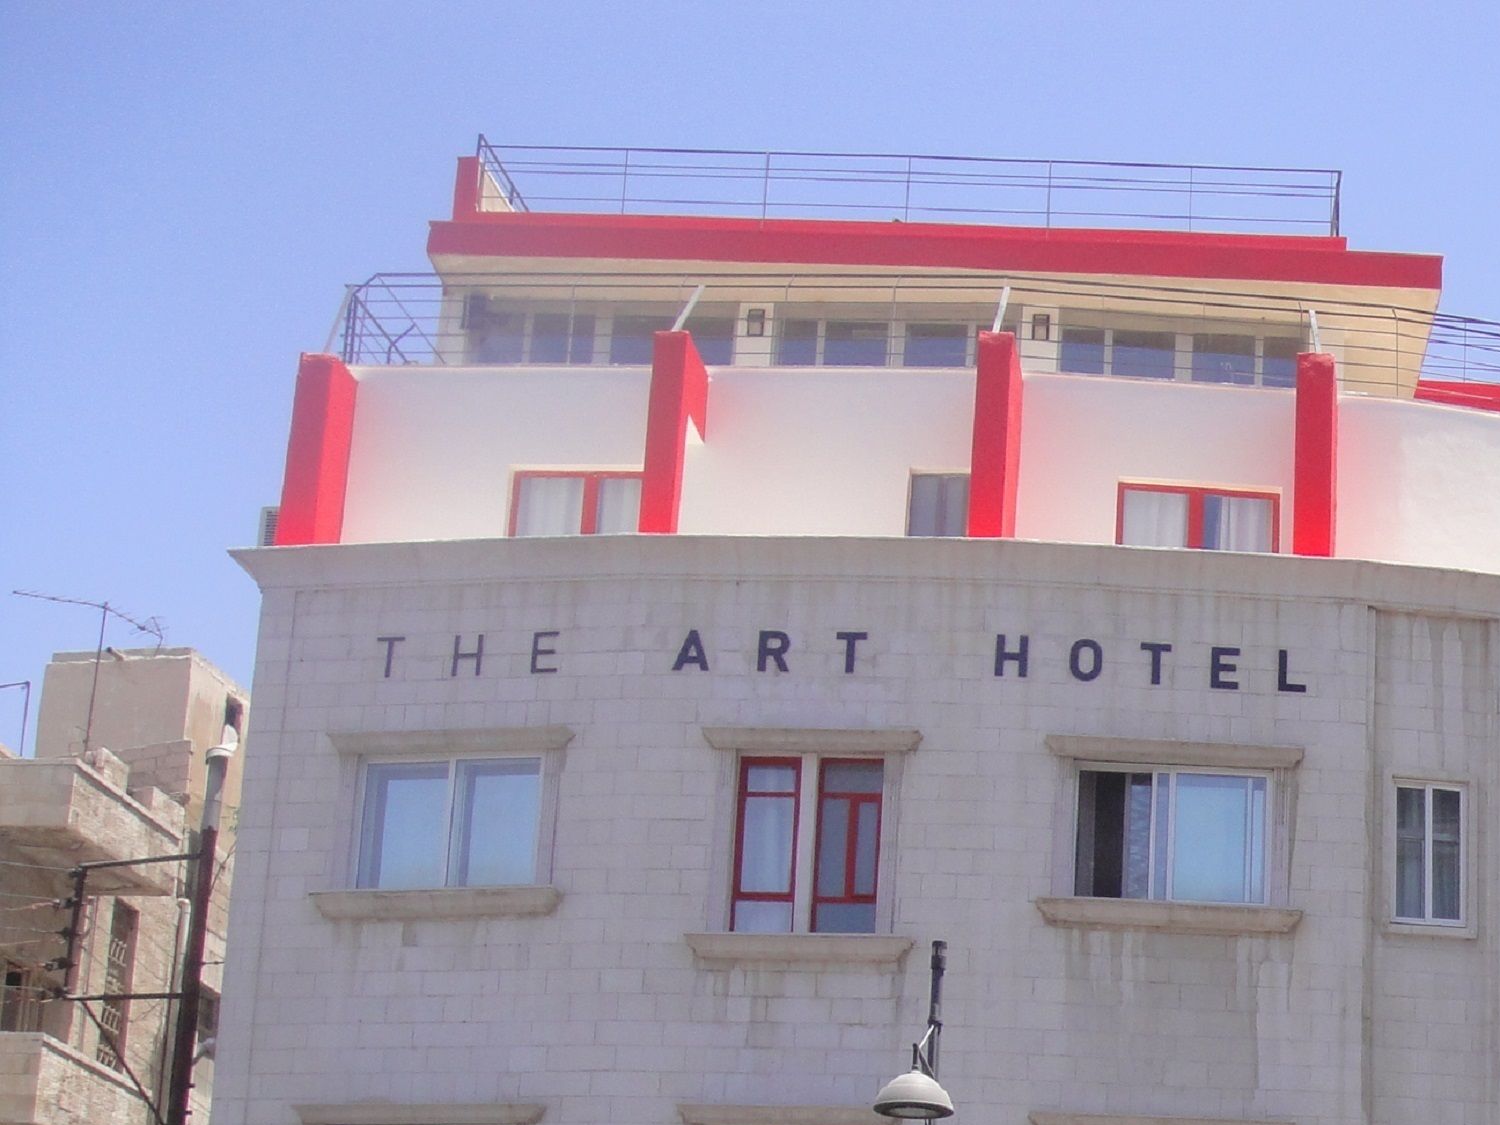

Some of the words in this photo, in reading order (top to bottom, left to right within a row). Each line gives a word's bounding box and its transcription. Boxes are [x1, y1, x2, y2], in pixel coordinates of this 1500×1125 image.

[377, 631, 560, 678] THE
[671, 629, 868, 674] ART
[994, 633, 1307, 693] HOTEL
